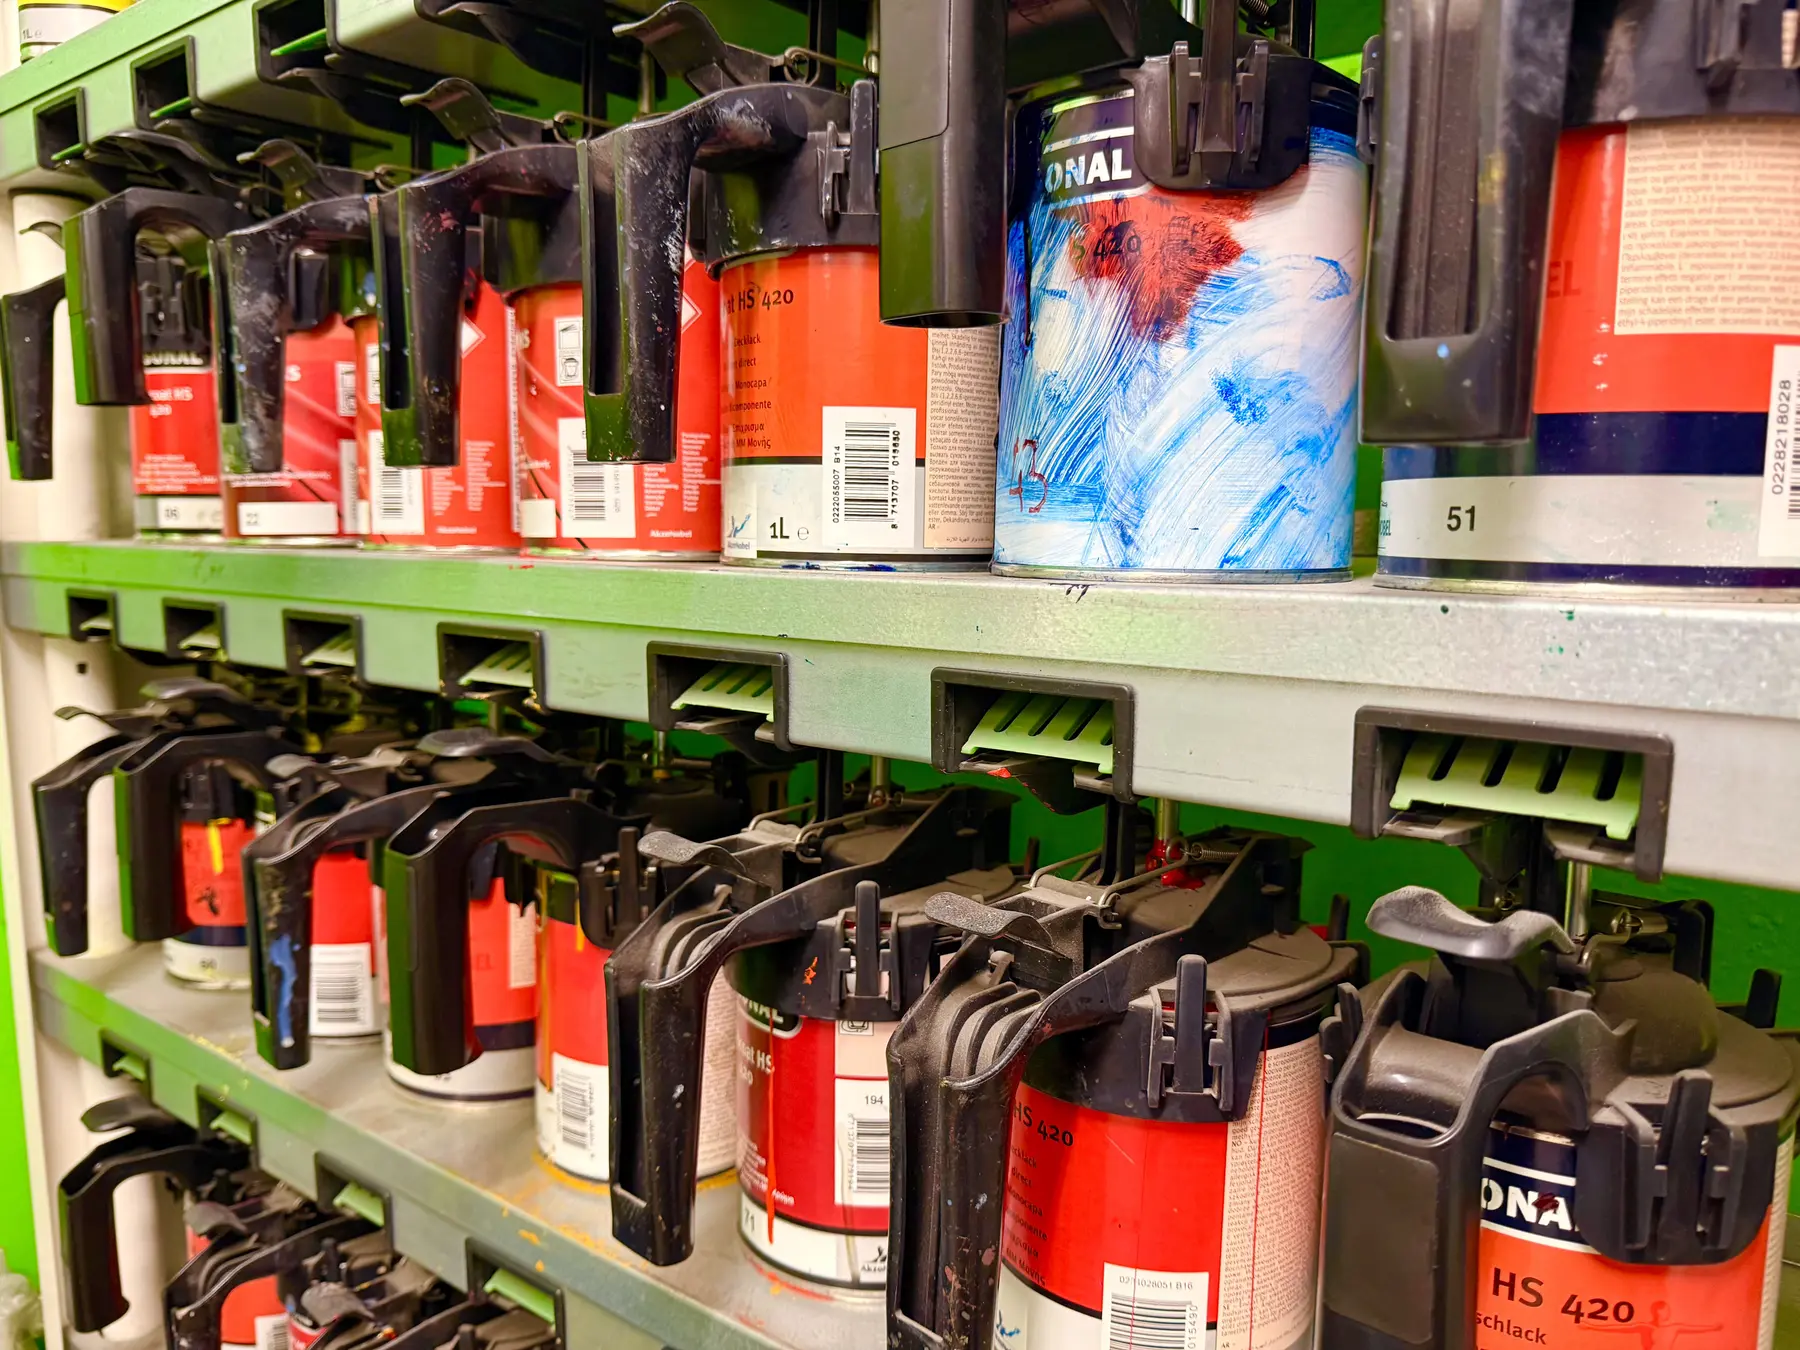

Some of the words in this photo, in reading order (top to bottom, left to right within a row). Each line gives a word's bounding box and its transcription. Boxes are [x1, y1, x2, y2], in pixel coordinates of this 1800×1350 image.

[738, 289, 755, 312] HS
[761, 289, 794, 312] 420
[1772, 379, 1792, 496] 0228218028
[832, 469, 841, 524] 0222055007
[1446, 505, 1476, 532] 51
[769, 517, 790, 540] 1L
[864, 1094, 885, 1105] 194
[1014, 1101, 1033, 1128] HS
[1037, 1119, 1075, 1147] 420
[1480, 1178, 1581, 1233] ONA
[1492, 1266, 1545, 1308] HS
[1560, 1294, 1636, 1325] 420
